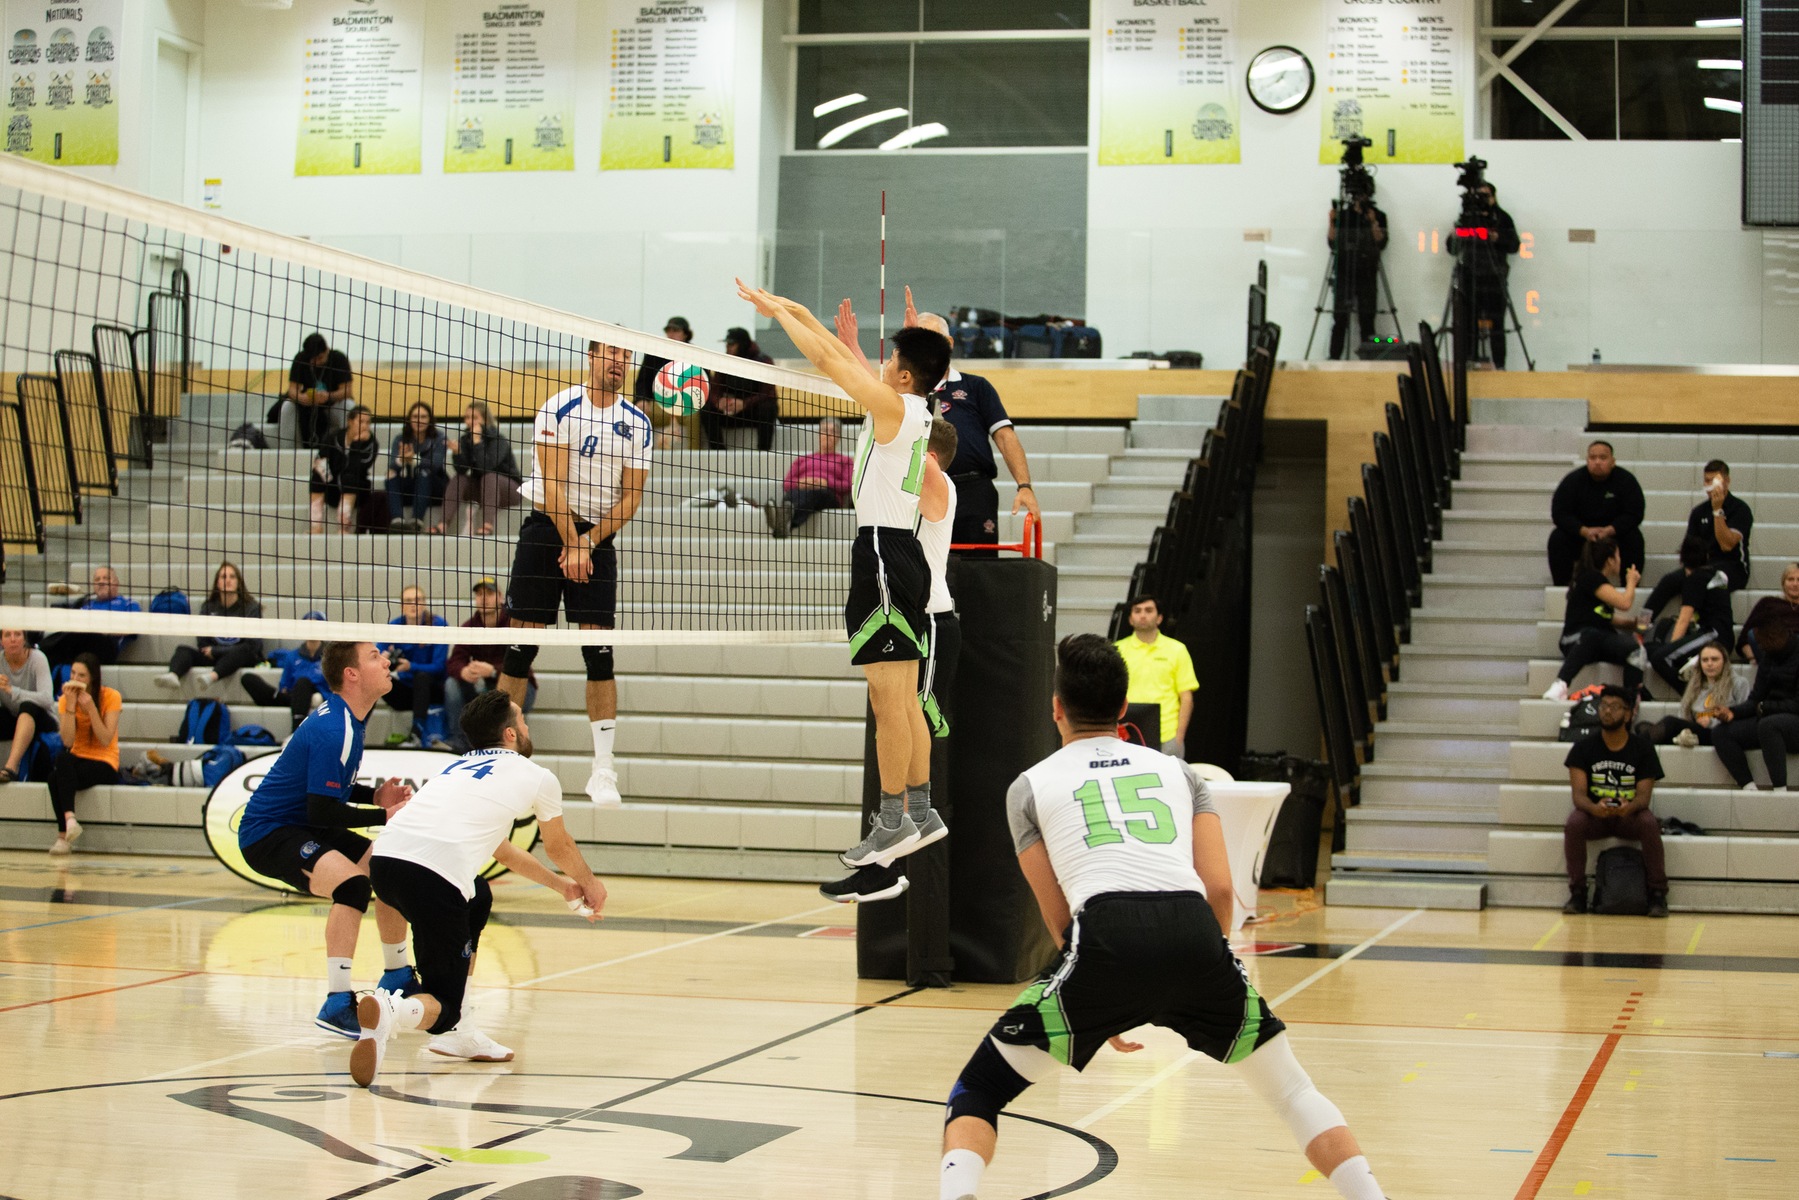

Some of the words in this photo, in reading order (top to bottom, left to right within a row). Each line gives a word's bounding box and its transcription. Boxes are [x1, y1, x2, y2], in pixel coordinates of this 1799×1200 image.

[46, 8, 83, 22] NATIONALS
[483, 10, 545, 20] BADMINTON
[640, 6, 704, 16] BADMINTON
[333, 16, 393, 26] BADMINTON
[1338, 16, 1378, 24] WOMEN'S
[580, 435, 599, 458] 8
[441, 759, 498, 780] 14
[1073, 773, 1177, 849] 15
